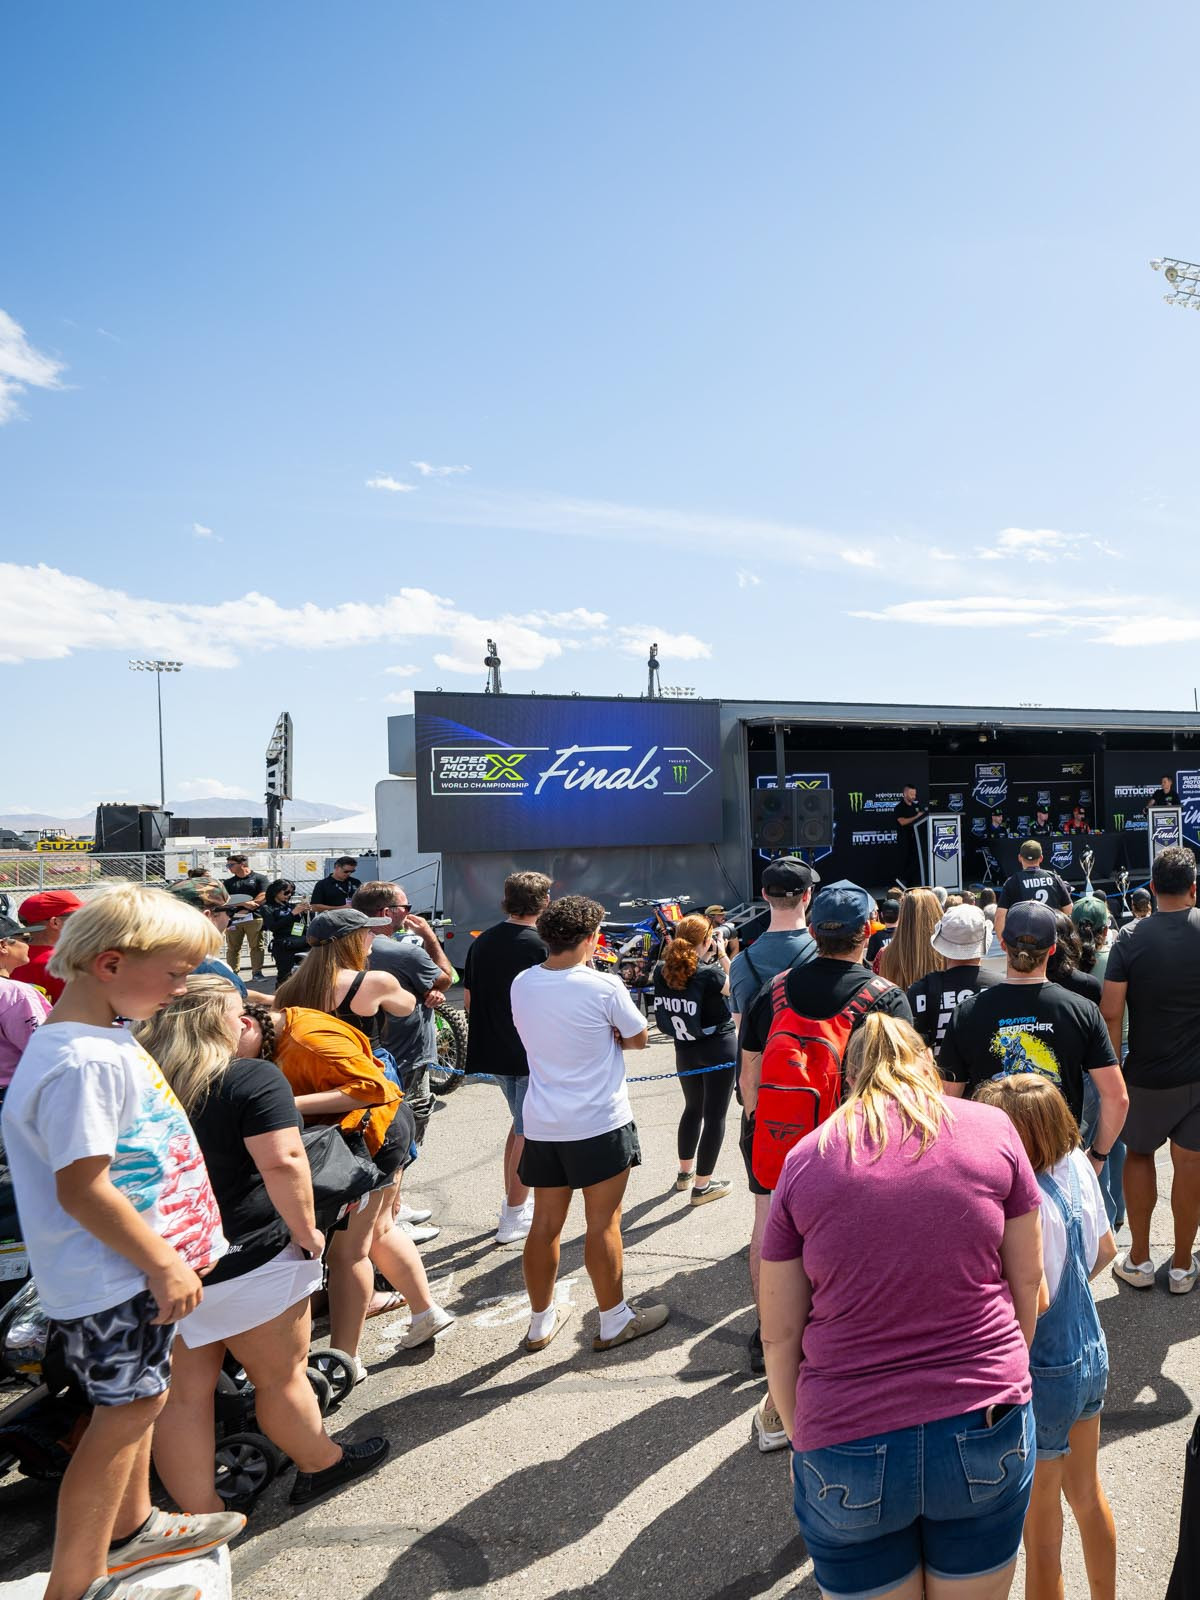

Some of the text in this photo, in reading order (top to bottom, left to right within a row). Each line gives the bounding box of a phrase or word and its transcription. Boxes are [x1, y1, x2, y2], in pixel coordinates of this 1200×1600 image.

[440, 756, 488, 764] SUPER
[443, 763, 486, 772] MOTO
[534, 744, 662, 795] Finals
[440, 771, 488, 779] CROSS
[971, 779, 1008, 797] Finals
[1114, 787, 1163, 796] MOTOCRO
[852, 833, 898, 842] MOTOCR
[1151, 826, 1180, 841] Finals
[40, 843, 96, 851] SUZUK
[1050, 850, 1073, 863] Finals
[1022, 877, 1054, 889] VIDEO
[653, 996, 697, 1017] PHOTO
